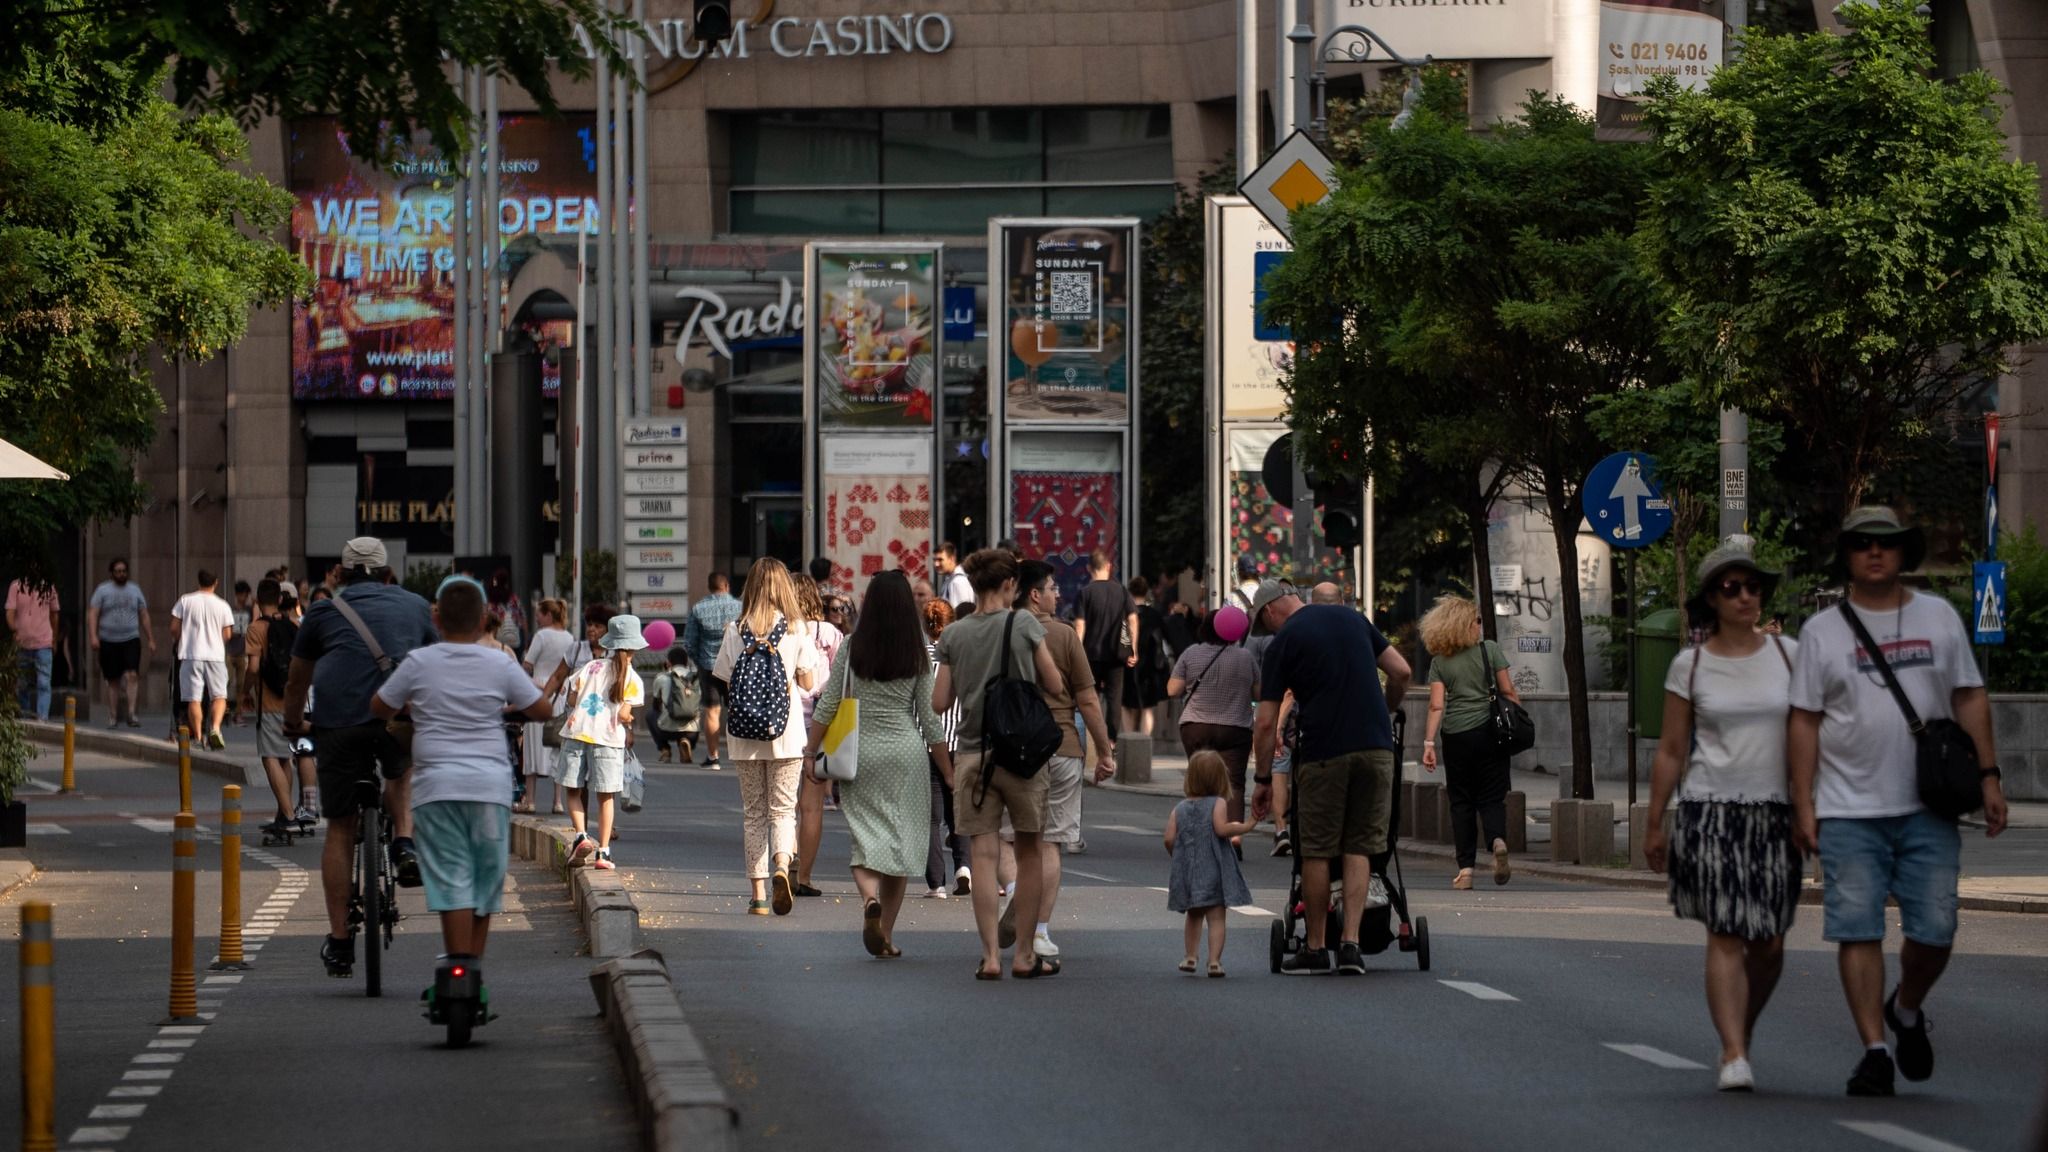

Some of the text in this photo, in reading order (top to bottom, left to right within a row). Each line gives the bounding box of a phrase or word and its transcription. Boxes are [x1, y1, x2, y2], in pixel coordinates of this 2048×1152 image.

[769, 12, 953, 58] CASINO
[1630, 42, 1708, 61] 021 9406
[1634, 64, 1682, 76] Nordului
[1684, 65, 1698, 76] 98
[497, 158, 540, 174] ASINO
[313, 199, 380, 236] WE
[370, 247, 428, 272] LIVE
[1034, 258, 1087, 269] SUNDAY
[848, 279, 895, 289] SUNDAY
[943, 353, 977, 369] TEL
[1067, 383, 1103, 392] Garden
[637, 451, 673, 466] prime
[1725, 471, 1745, 483] BNE
[1726, 482, 1745, 490] WAS
[1726, 489, 1745, 497] HERE
[358, 501, 401, 523] THE
[639, 500, 673, 513] SHARKIA
